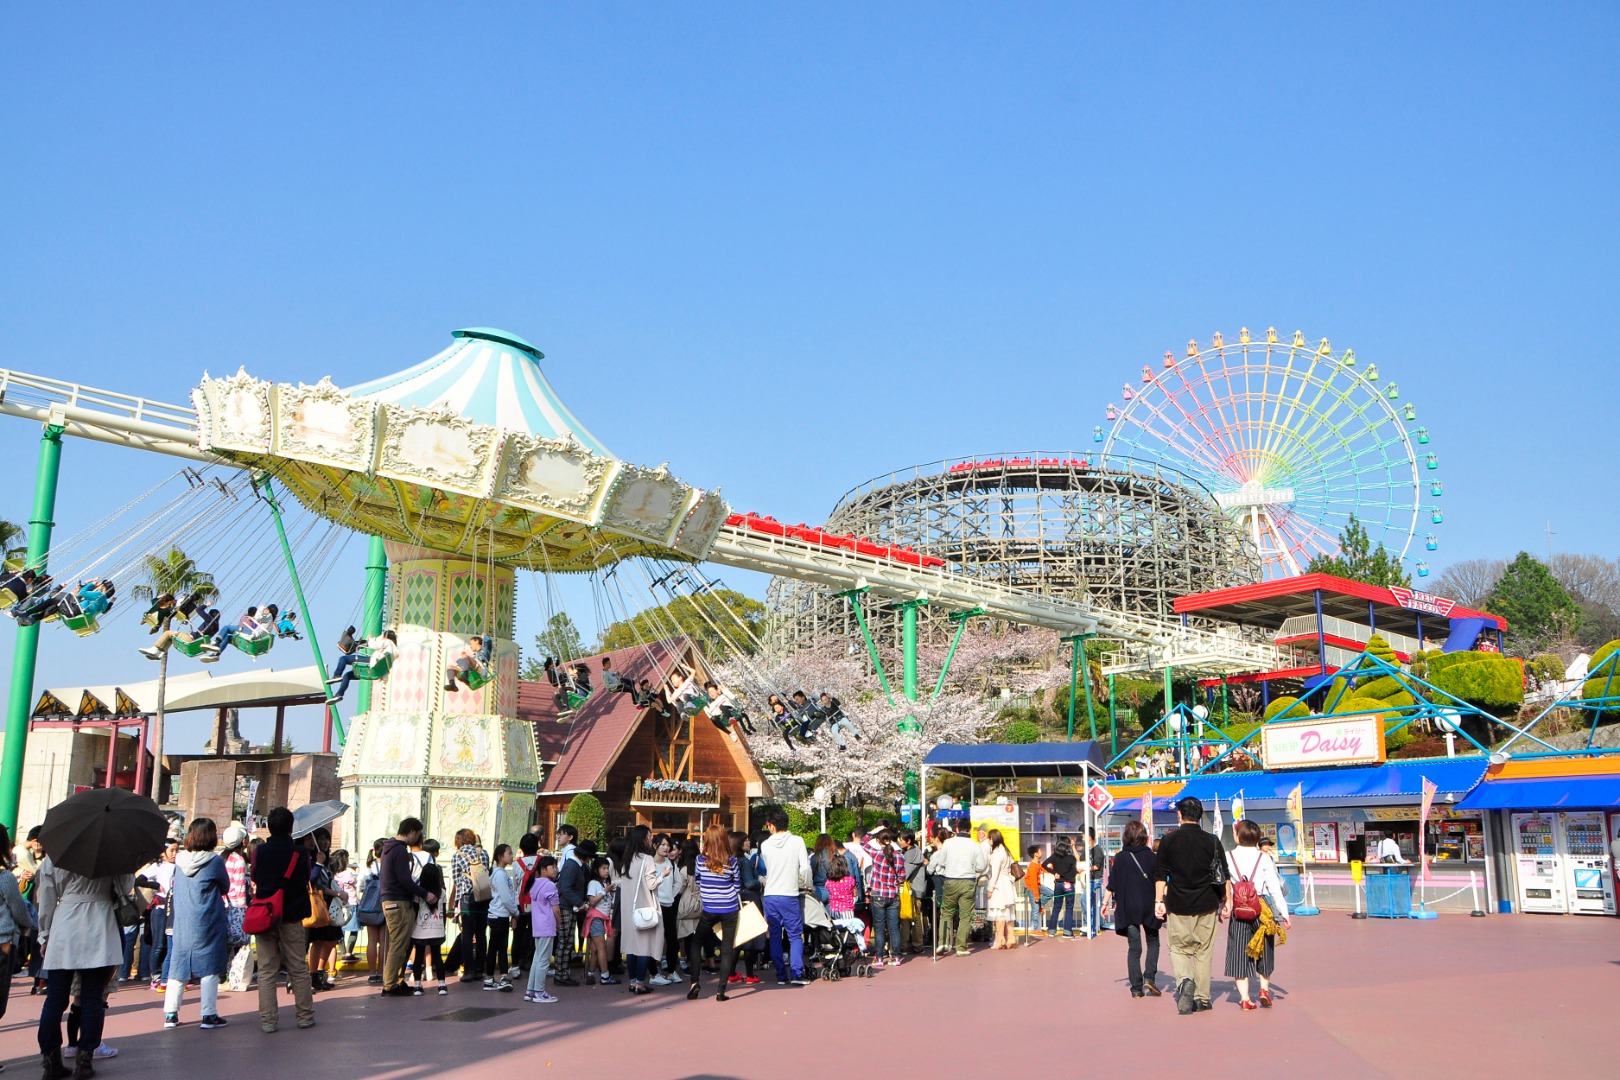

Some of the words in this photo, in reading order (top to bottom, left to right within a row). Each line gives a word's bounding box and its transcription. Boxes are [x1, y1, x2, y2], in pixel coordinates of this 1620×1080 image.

[1418, 592, 1434, 602] RED
[1411, 601, 1442, 613] FALCON
[1273, 742, 1298, 753] SHOP
[1300, 730, 1362, 756] Daisy
